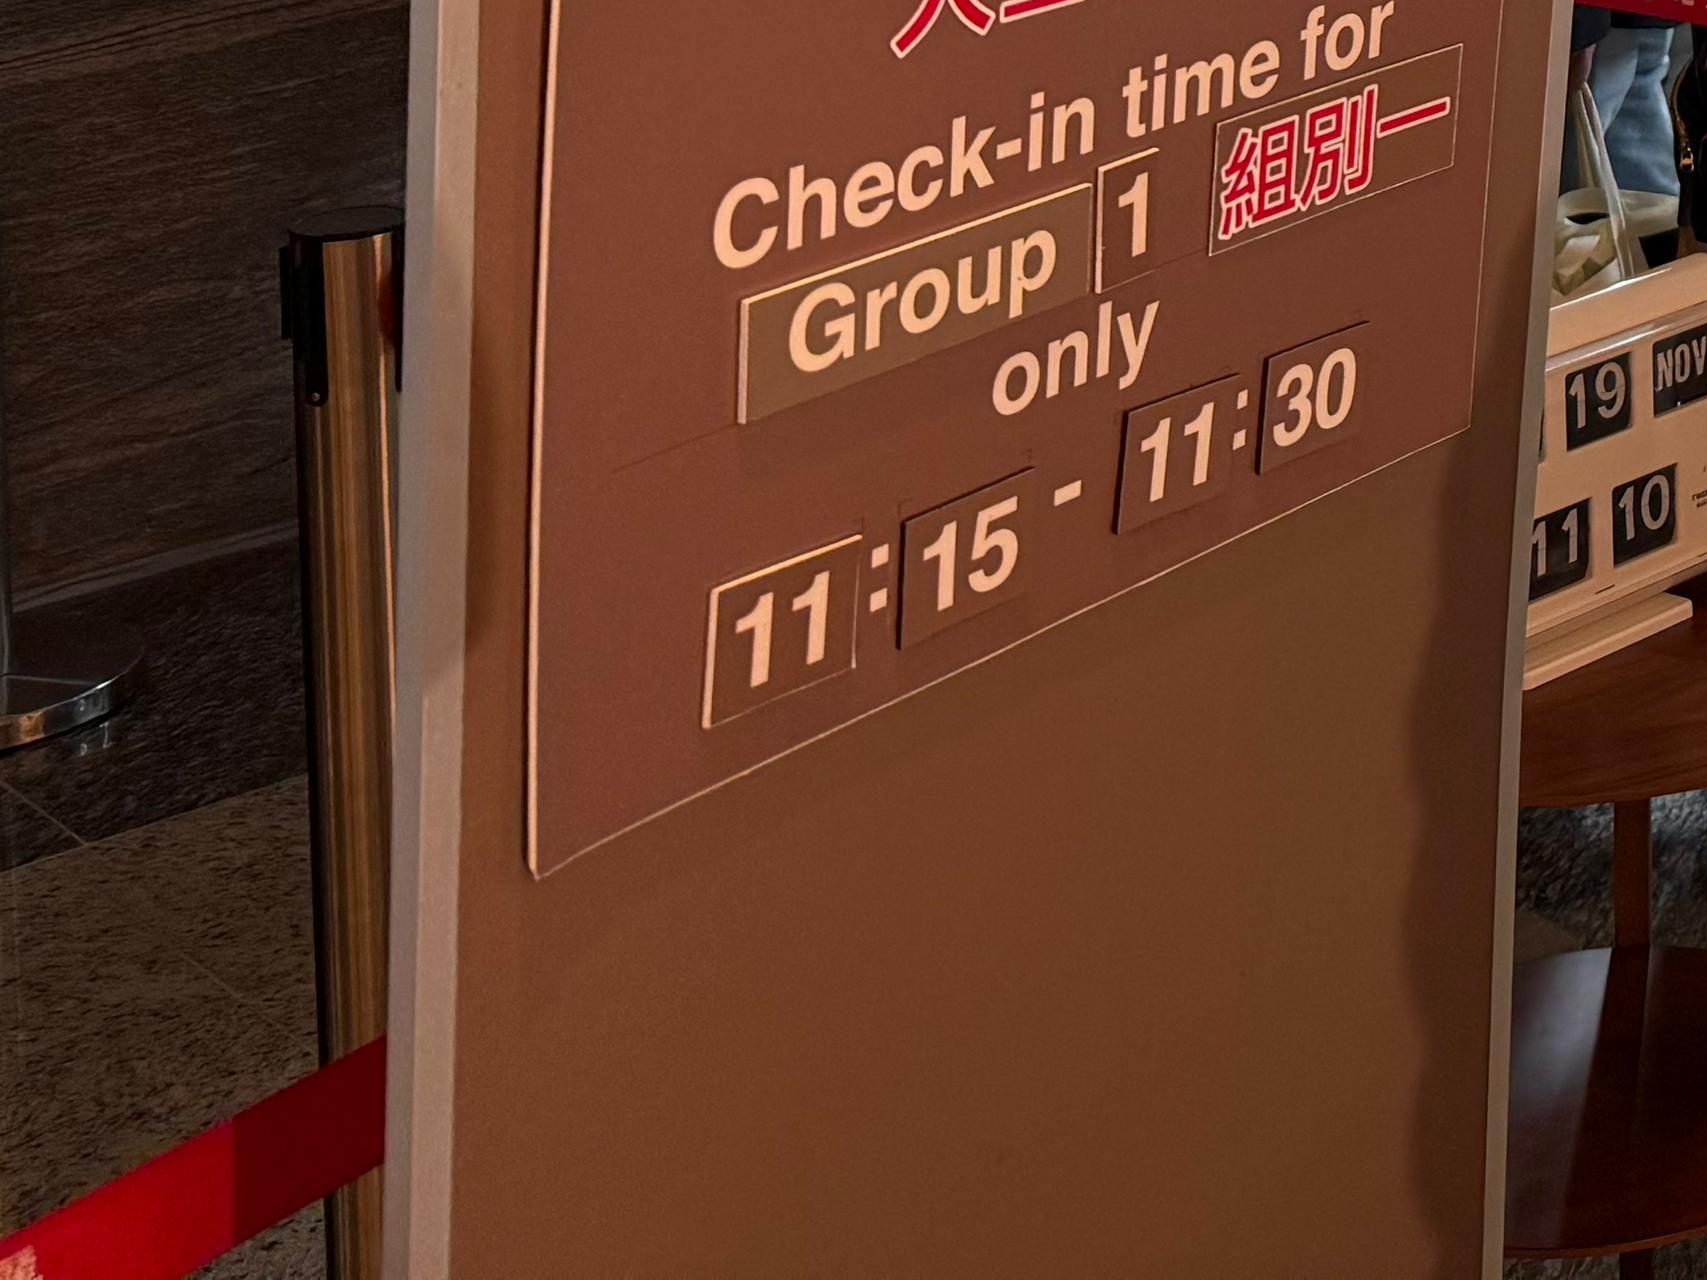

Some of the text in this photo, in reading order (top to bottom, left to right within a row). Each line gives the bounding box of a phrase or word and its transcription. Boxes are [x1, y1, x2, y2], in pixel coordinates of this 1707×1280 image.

[713, 0, 1395, 270] Check-in time for
[787, 88, 1453, 374] Group 1 組別一
[991, 294, 1160, 419] only
[1568, 336, 1707, 430] 19 NOV
[1618, 473, 1671, 542] 10
